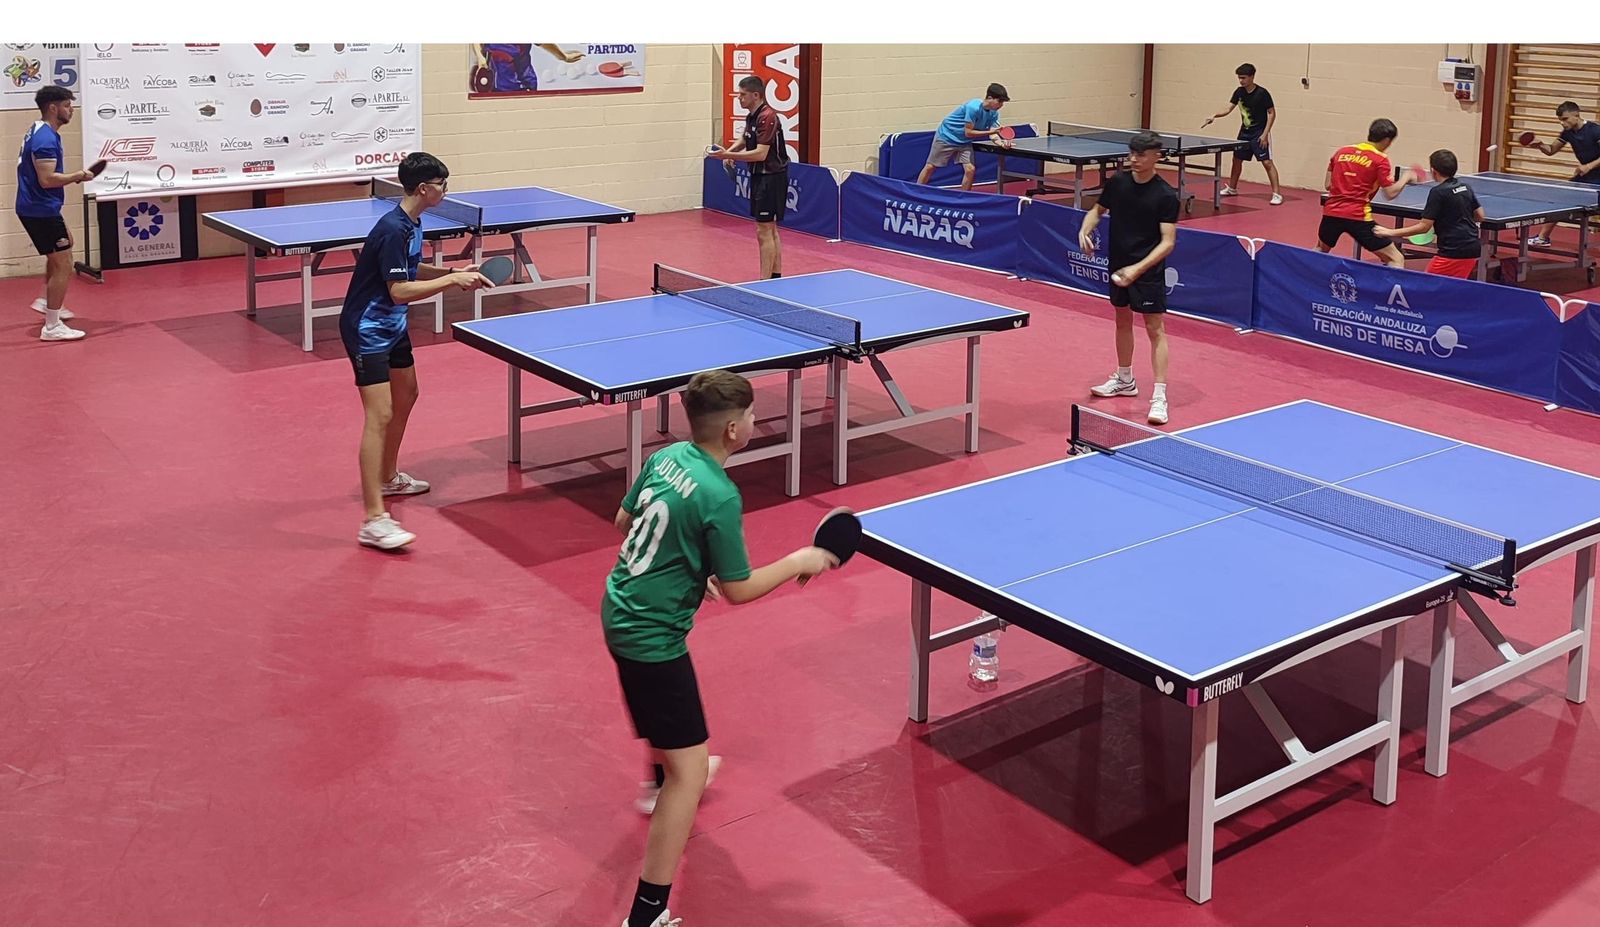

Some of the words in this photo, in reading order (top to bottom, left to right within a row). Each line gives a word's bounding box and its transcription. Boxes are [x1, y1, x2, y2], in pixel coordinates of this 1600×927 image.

[588, 44, 637, 54] PARTIDO.
[53, 59, 78, 87] 5
[355, 152, 408, 165] DORCAS
[1338, 153, 1373, 168] ESPAÑA
[886, 200, 923, 212] TABLE
[928, 207, 975, 221] TENNIS
[883, 207, 974, 250] NARAQ
[138, 242, 175, 252] GENERAL
[1067, 250, 1109, 266] FEDERACIÓ
[1069, 263, 1100, 281] TENIS
[1312, 302, 1372, 323] FEDERACIÓN
[1373, 314, 1427, 335] ANDALUZA
[1313, 318, 1353, 338] TENIS
[1357, 328, 1377, 344] DE
[1381, 333, 1426, 355] MESA
[614, 388, 648, 403] BUTTERFLY
[654, 456, 698, 499] JULIÁN
[1203, 671, 1244, 702] BUTTERFLY
